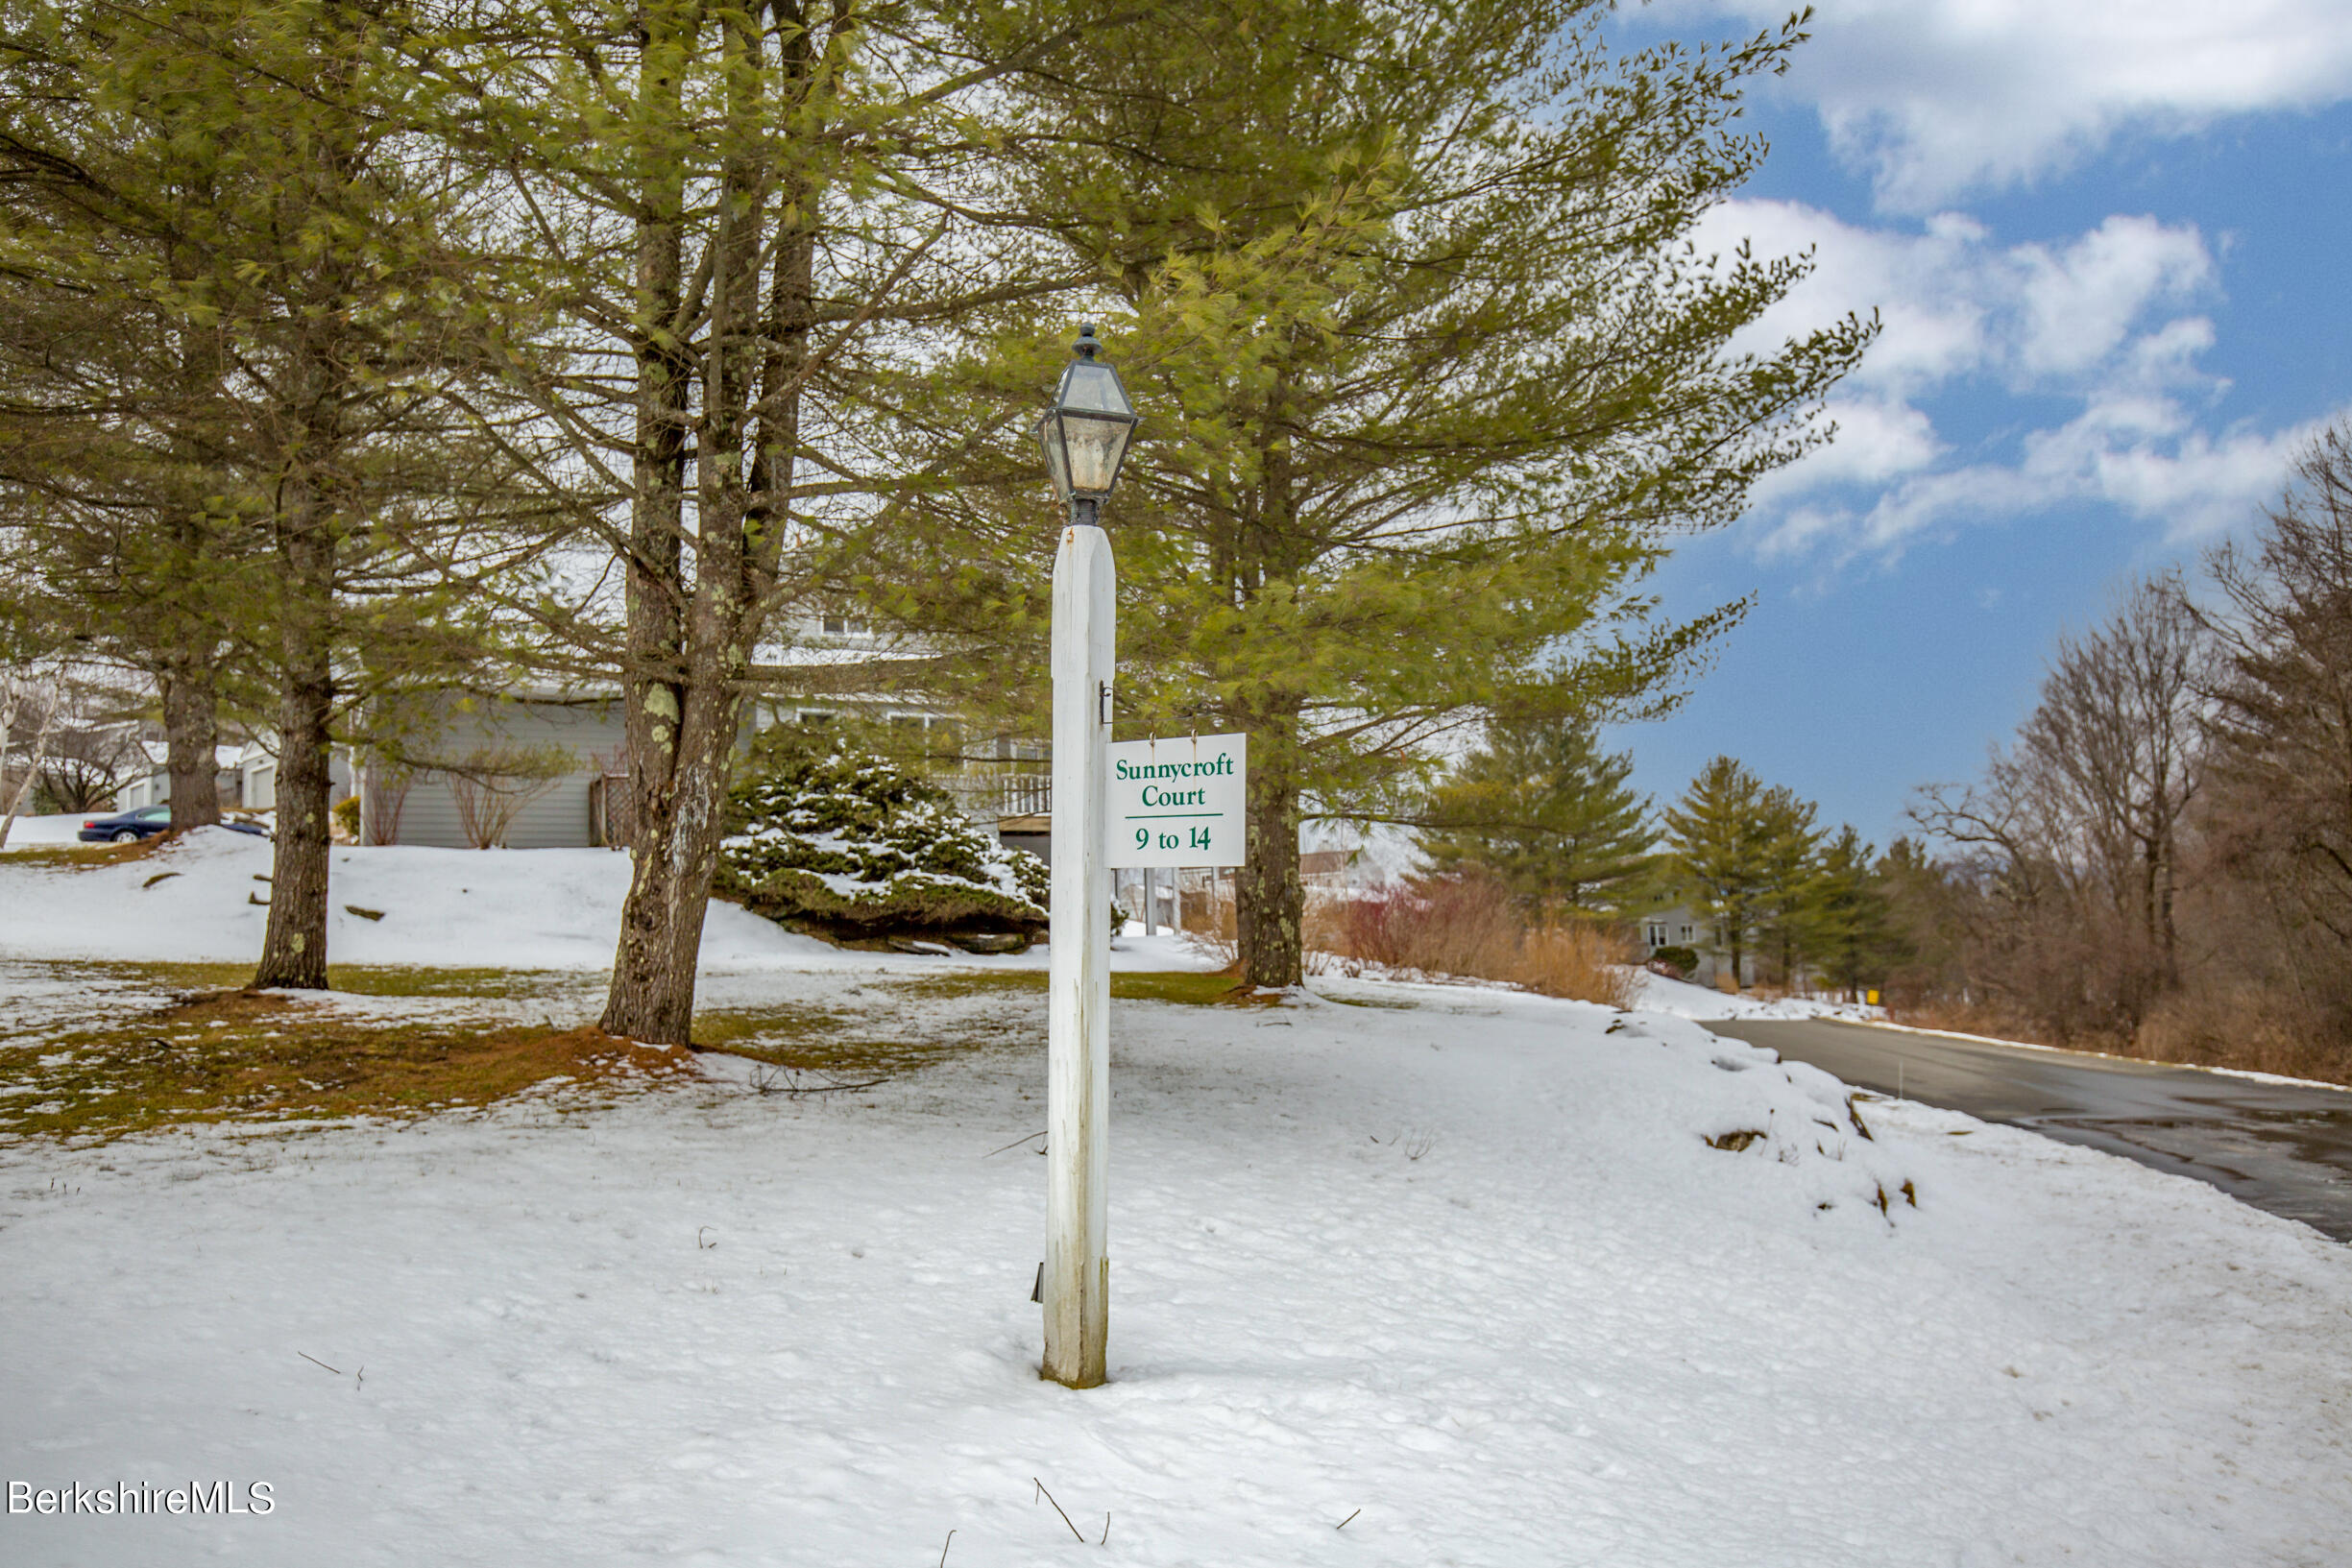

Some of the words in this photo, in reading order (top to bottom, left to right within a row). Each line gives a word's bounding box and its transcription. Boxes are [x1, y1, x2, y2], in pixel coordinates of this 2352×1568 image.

[1116, 752, 1234, 784] Sunnycroft
[1141, 784, 1206, 808] Court
[1135, 828, 1150, 851] 9
[1158, 832, 1179, 850] to
[1189, 826, 1212, 852] 14
